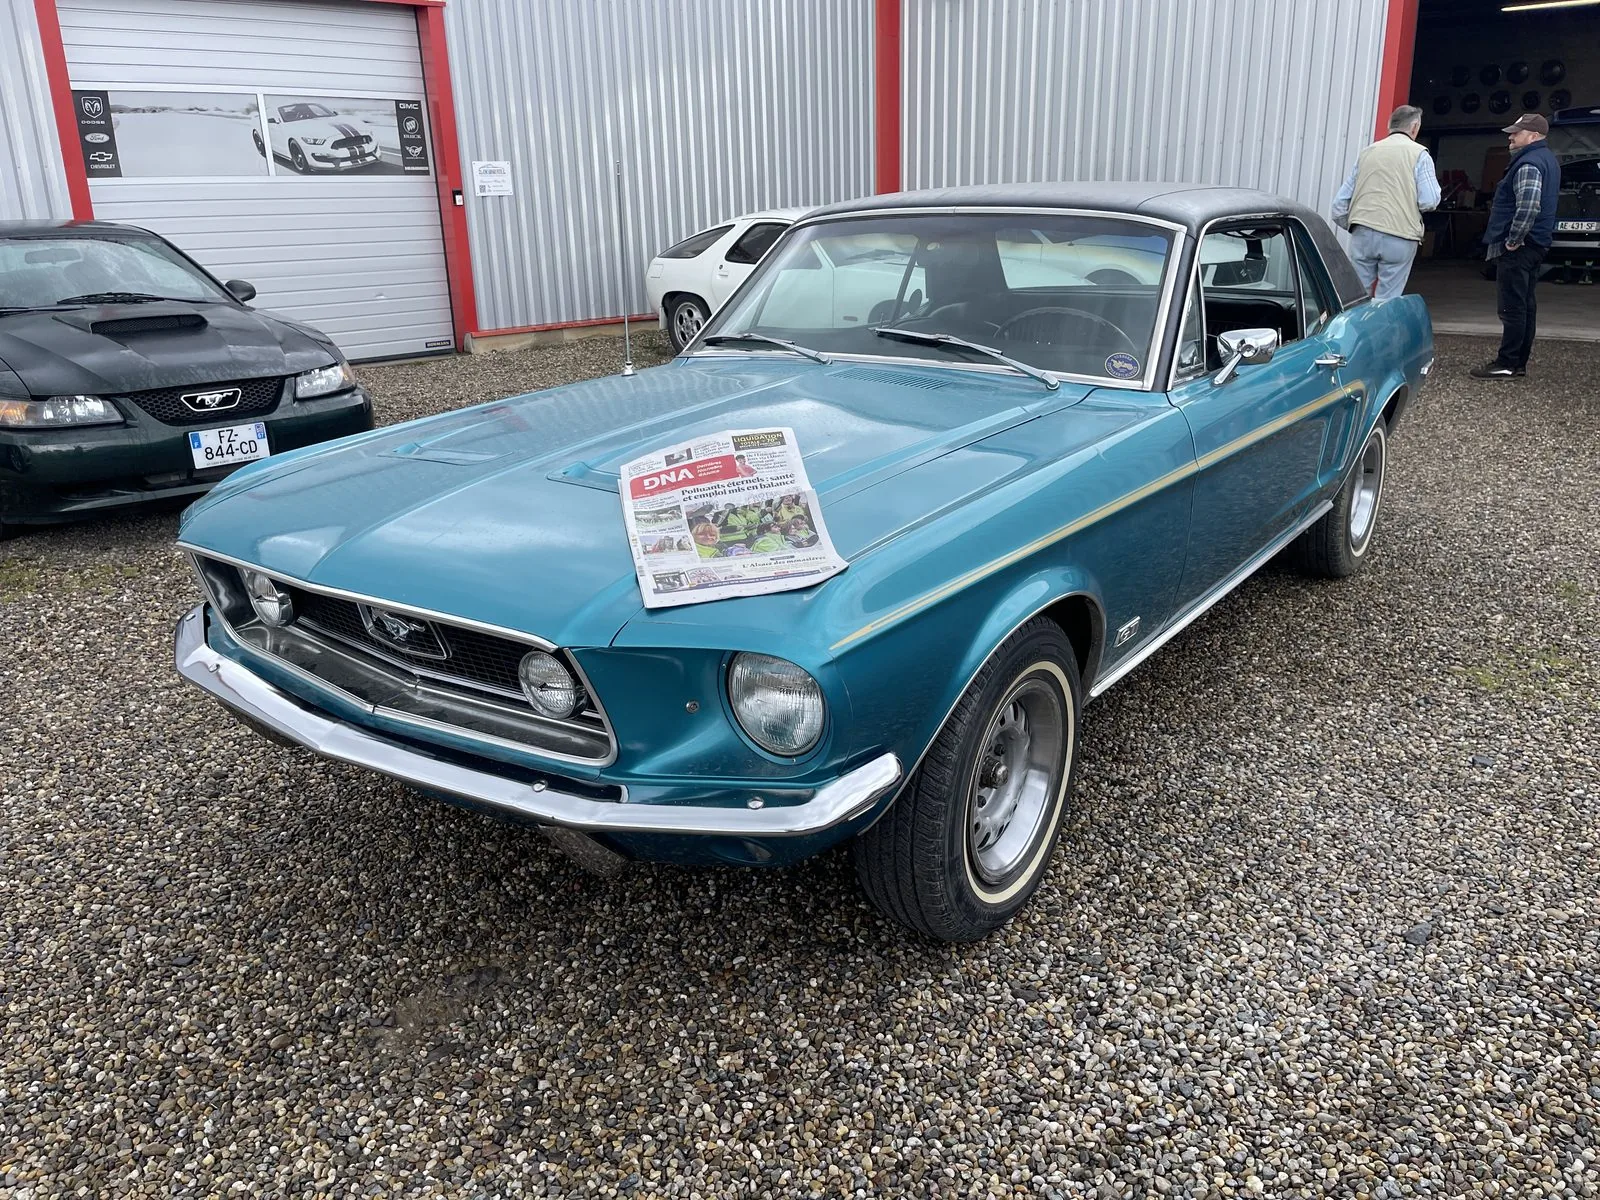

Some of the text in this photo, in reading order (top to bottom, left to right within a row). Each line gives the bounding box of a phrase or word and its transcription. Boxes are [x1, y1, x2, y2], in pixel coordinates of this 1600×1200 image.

[733, 433, 782, 443] LIQUIDATION
[204, 440, 258, 460] 844-CD
[643, 468, 694, 490] DNA
[681, 484, 726, 496] Polluants
[727, 476, 764, 488] éternels
[769, 472, 795, 482] santé
[682, 494, 693, 502] et
[694, 489, 727, 501] emploi
[728, 486, 746, 495] mis
[759, 479, 796, 490] balance
